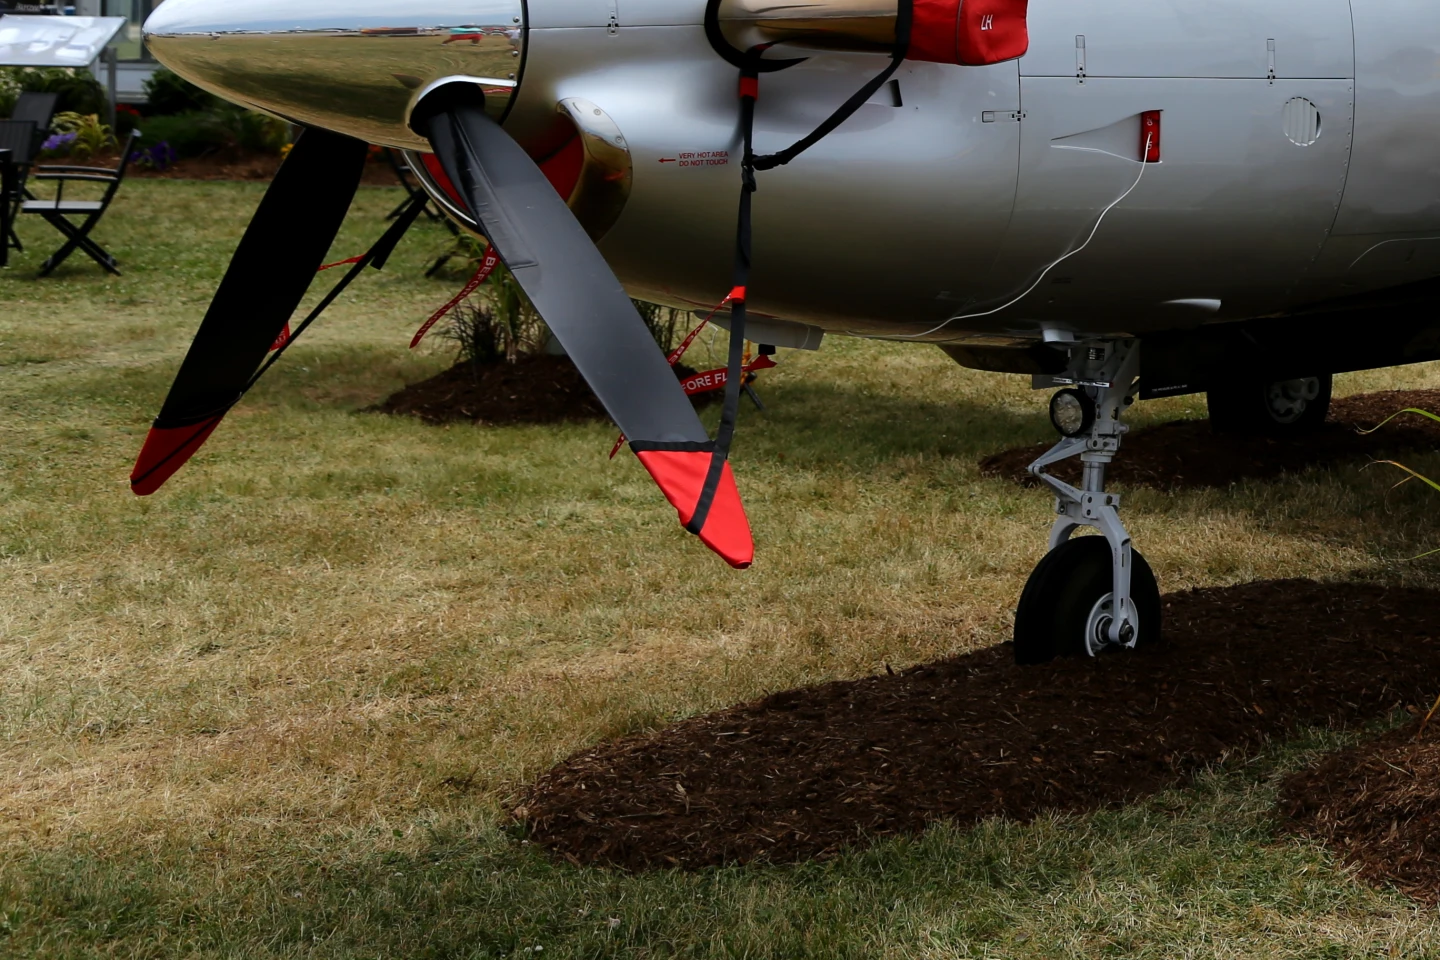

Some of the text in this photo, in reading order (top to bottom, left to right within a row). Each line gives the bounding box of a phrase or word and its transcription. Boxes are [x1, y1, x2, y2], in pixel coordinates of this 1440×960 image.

[980, 14, 993, 30] LH
[697, 151, 710, 159] HOT
[712, 150, 729, 158] AREA
[706, 158, 728, 166] TOUCH
